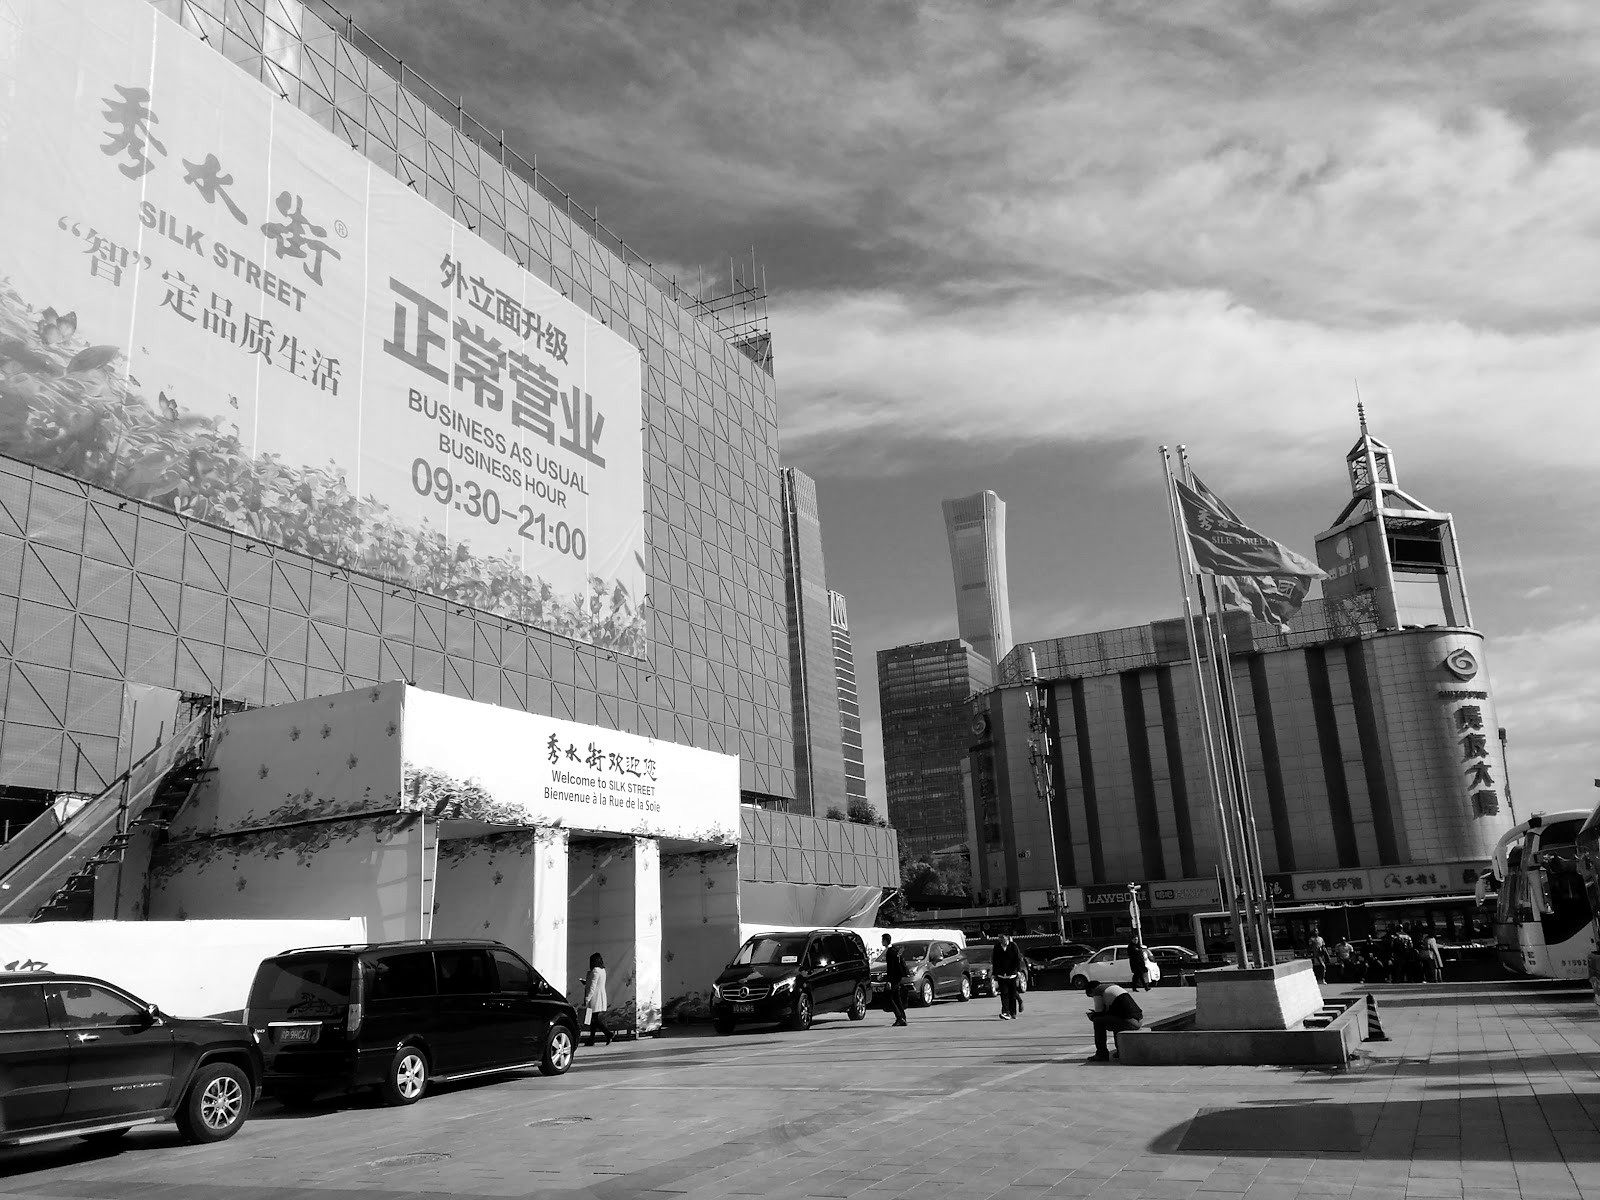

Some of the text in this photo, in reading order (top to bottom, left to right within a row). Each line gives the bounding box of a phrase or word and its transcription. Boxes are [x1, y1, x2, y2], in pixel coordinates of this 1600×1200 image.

[99, 83, 342, 287] 秀水街
[138, 200, 307, 313] SILK STREET
[440, 252, 569, 366] 外立面升级
[383, 275, 606, 470] 正常营业
[408, 387, 590, 496] BUSINESS AS USUAL
[438, 432, 568, 509] BUSINESS HOUR
[1211, 535, 1233, 545] SILK
[544, 786, 661, 813] Bienvenue à la Rue de la Soie
[547, 732, 658, 782] 秀水街欢迎您
[551, 769, 656, 797] Welcome to SILK STREET
